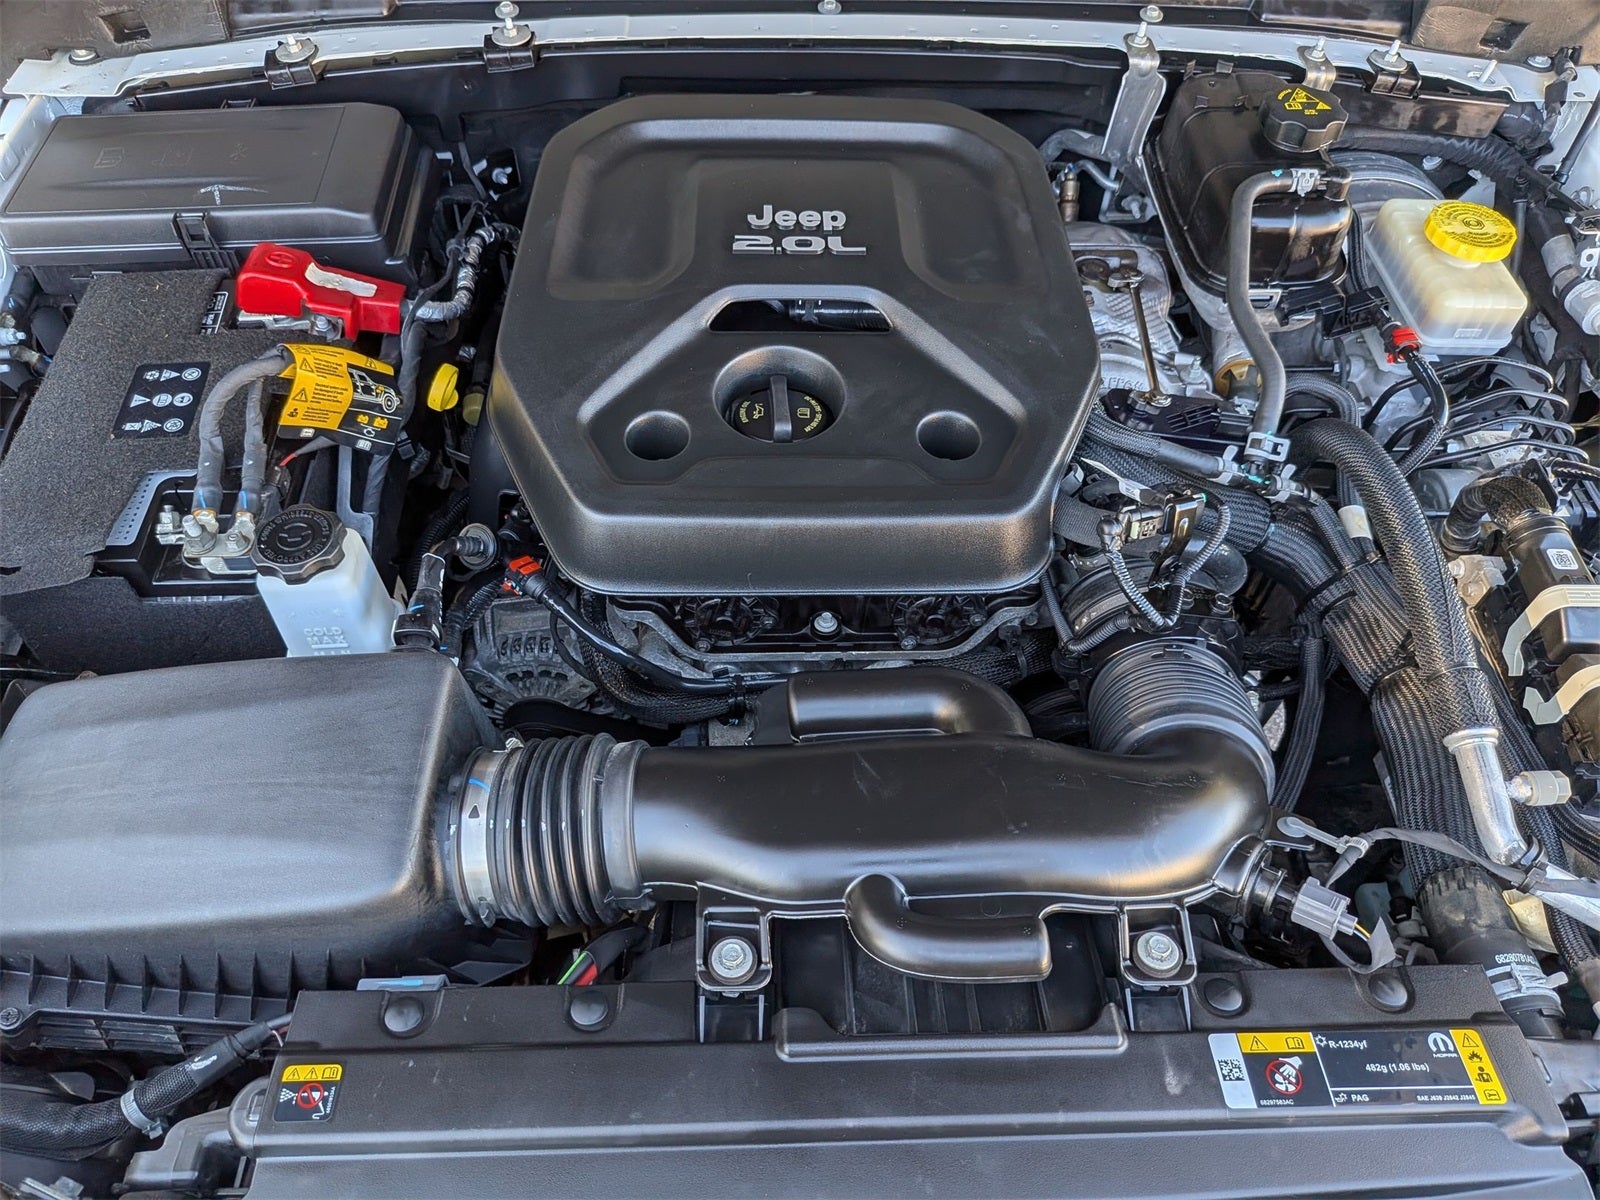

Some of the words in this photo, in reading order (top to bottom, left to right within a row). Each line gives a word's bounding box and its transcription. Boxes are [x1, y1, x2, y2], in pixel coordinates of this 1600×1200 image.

[747, 204, 846, 231] Jeep
[732, 235, 866, 255] 2.0L
[303, 626, 342, 636] COLD
[306, 635, 346, 645] MAX
[1329, 1040, 1368, 1050] R-1234yf
[1365, 1063, 1388, 1073] 482g
[1389, 1063, 1411, 1073] (1.06
[1412, 1063, 1430, 1073] lbs)
[1351, 1094, 1369, 1102] PAG
